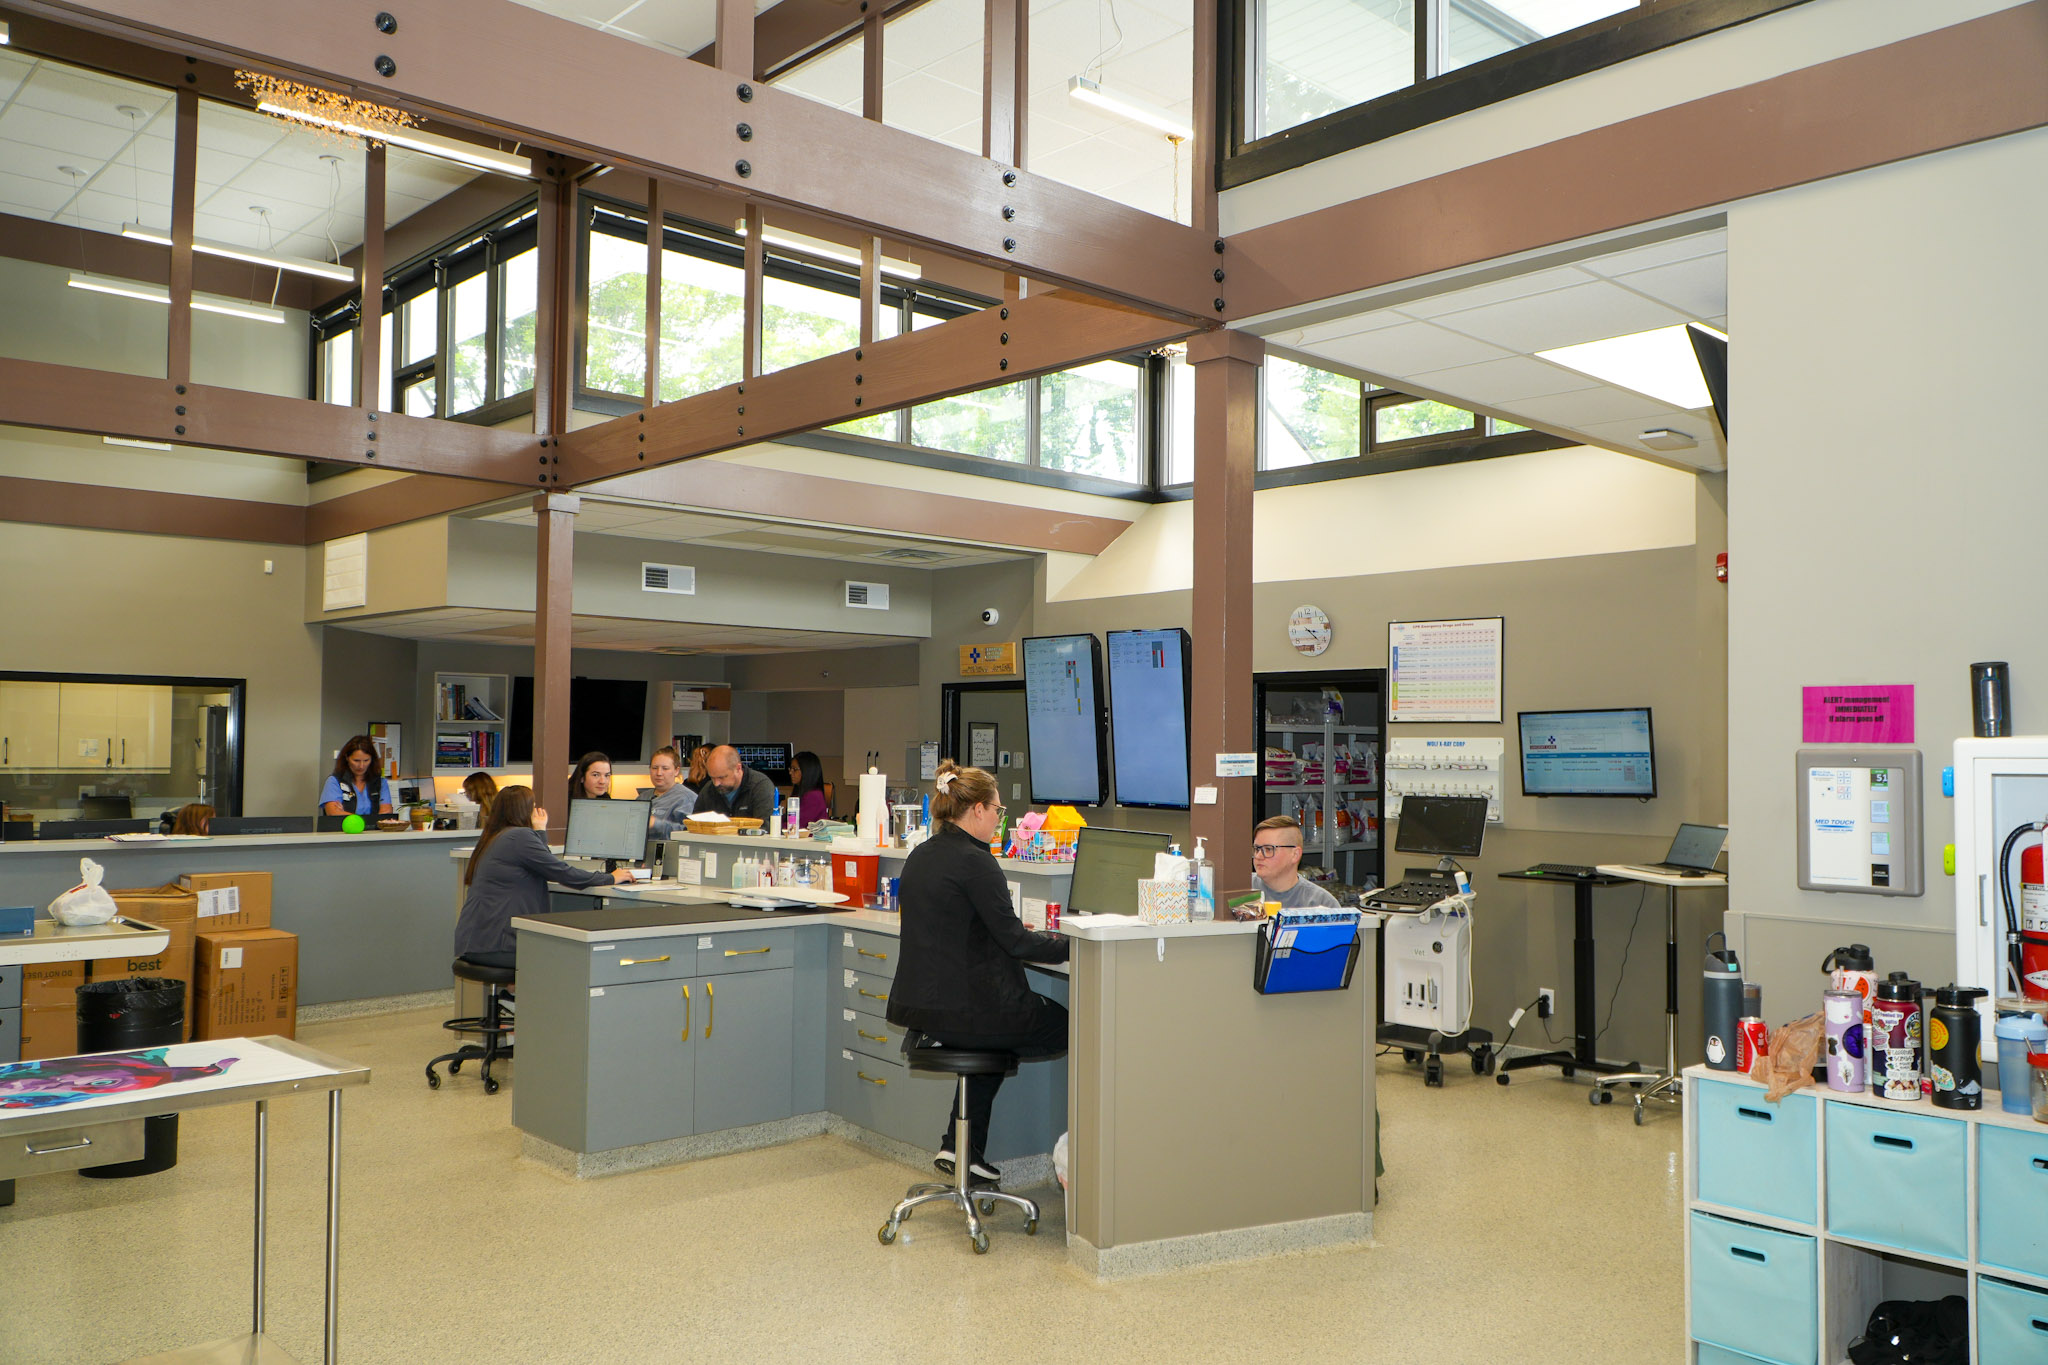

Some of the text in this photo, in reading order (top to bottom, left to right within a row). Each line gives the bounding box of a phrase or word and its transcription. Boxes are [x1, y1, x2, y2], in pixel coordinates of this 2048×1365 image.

[1844, 696, 1890, 704] management
[1835, 705, 1878, 713] IMMEDIATELY
[127, 958, 162, 972] best
